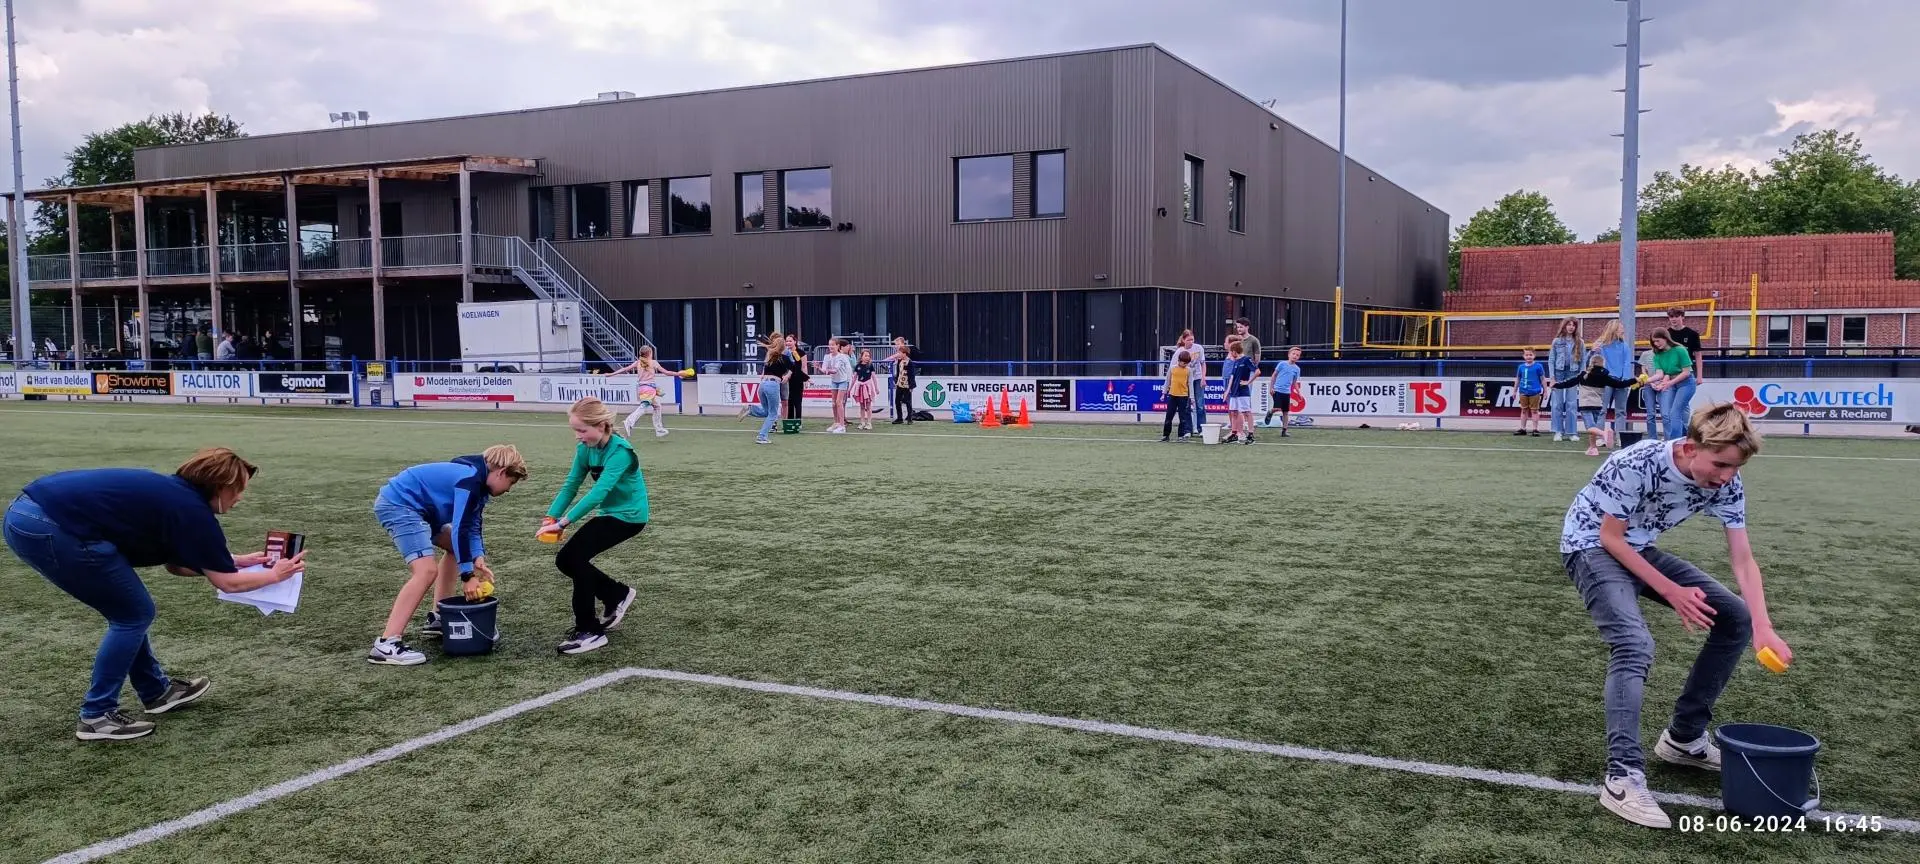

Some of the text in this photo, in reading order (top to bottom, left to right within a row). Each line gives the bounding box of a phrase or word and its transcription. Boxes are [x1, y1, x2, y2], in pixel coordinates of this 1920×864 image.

[462, 310, 500, 318] KOELWAGEN
[747, 305, 754, 318] 8
[746, 324, 755, 337] 9
[745, 344, 757, 356] 10
[34, 376, 88, 386] Hart van Delden
[109, 374, 166, 387] Showtime
[182, 374, 241, 389] FACILITOR
[426, 376, 512, 387] Modelmakerij Delden
[947, 383, 1035, 392] TEN VREGELAAR
[1308, 383, 1396, 396] THEO SONDER
[557, 386, 584, 401] WAPEN
[600, 387, 631, 402] DELDEN
[1103, 391, 1121, 402] ten
[1409, 382, 1447, 414] TS
[1113, 401, 1137, 411] dam
[1783, 409, 1888, 419] Graveer & Reclame
